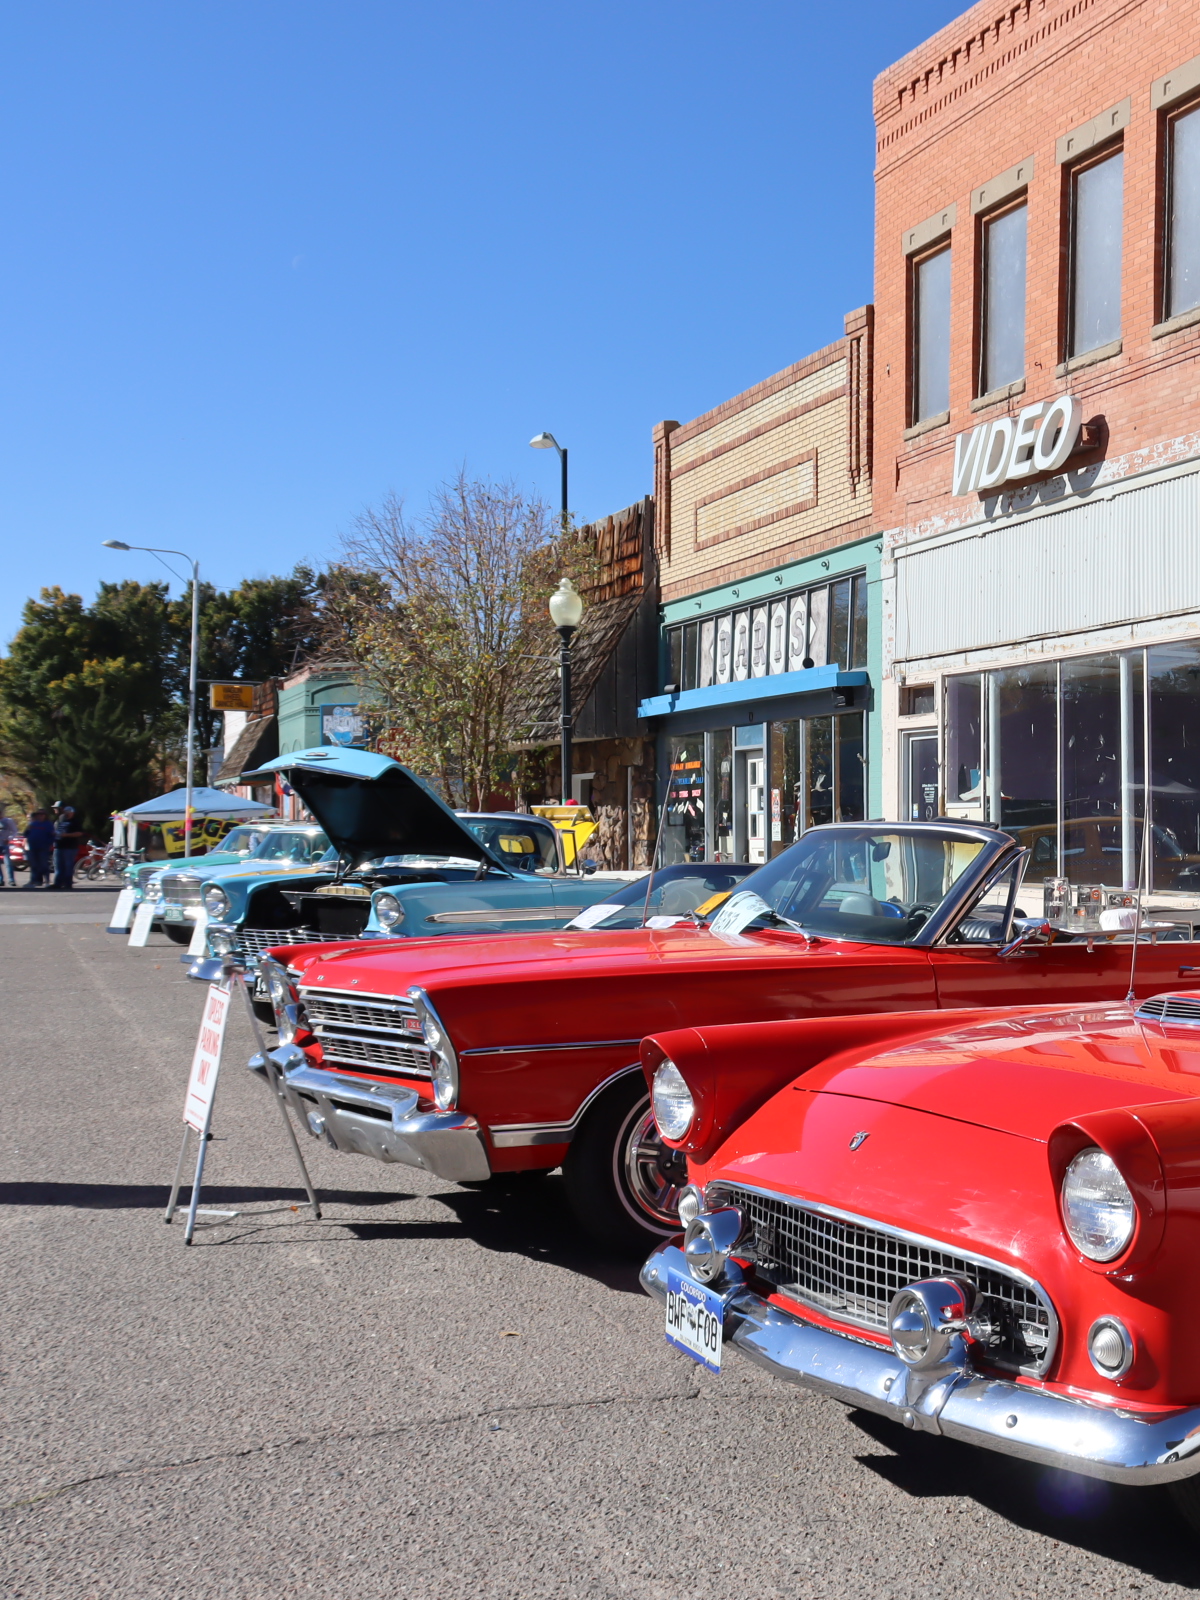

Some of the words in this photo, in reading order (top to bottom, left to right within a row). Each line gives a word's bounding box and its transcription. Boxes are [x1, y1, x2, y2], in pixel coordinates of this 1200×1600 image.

[952, 395, 1082, 497] VIDEO
[719, 611, 805, 675] PARIS
[667, 1290, 687, 1331] BWF
[681, 1280, 707, 1303] COLORADO
